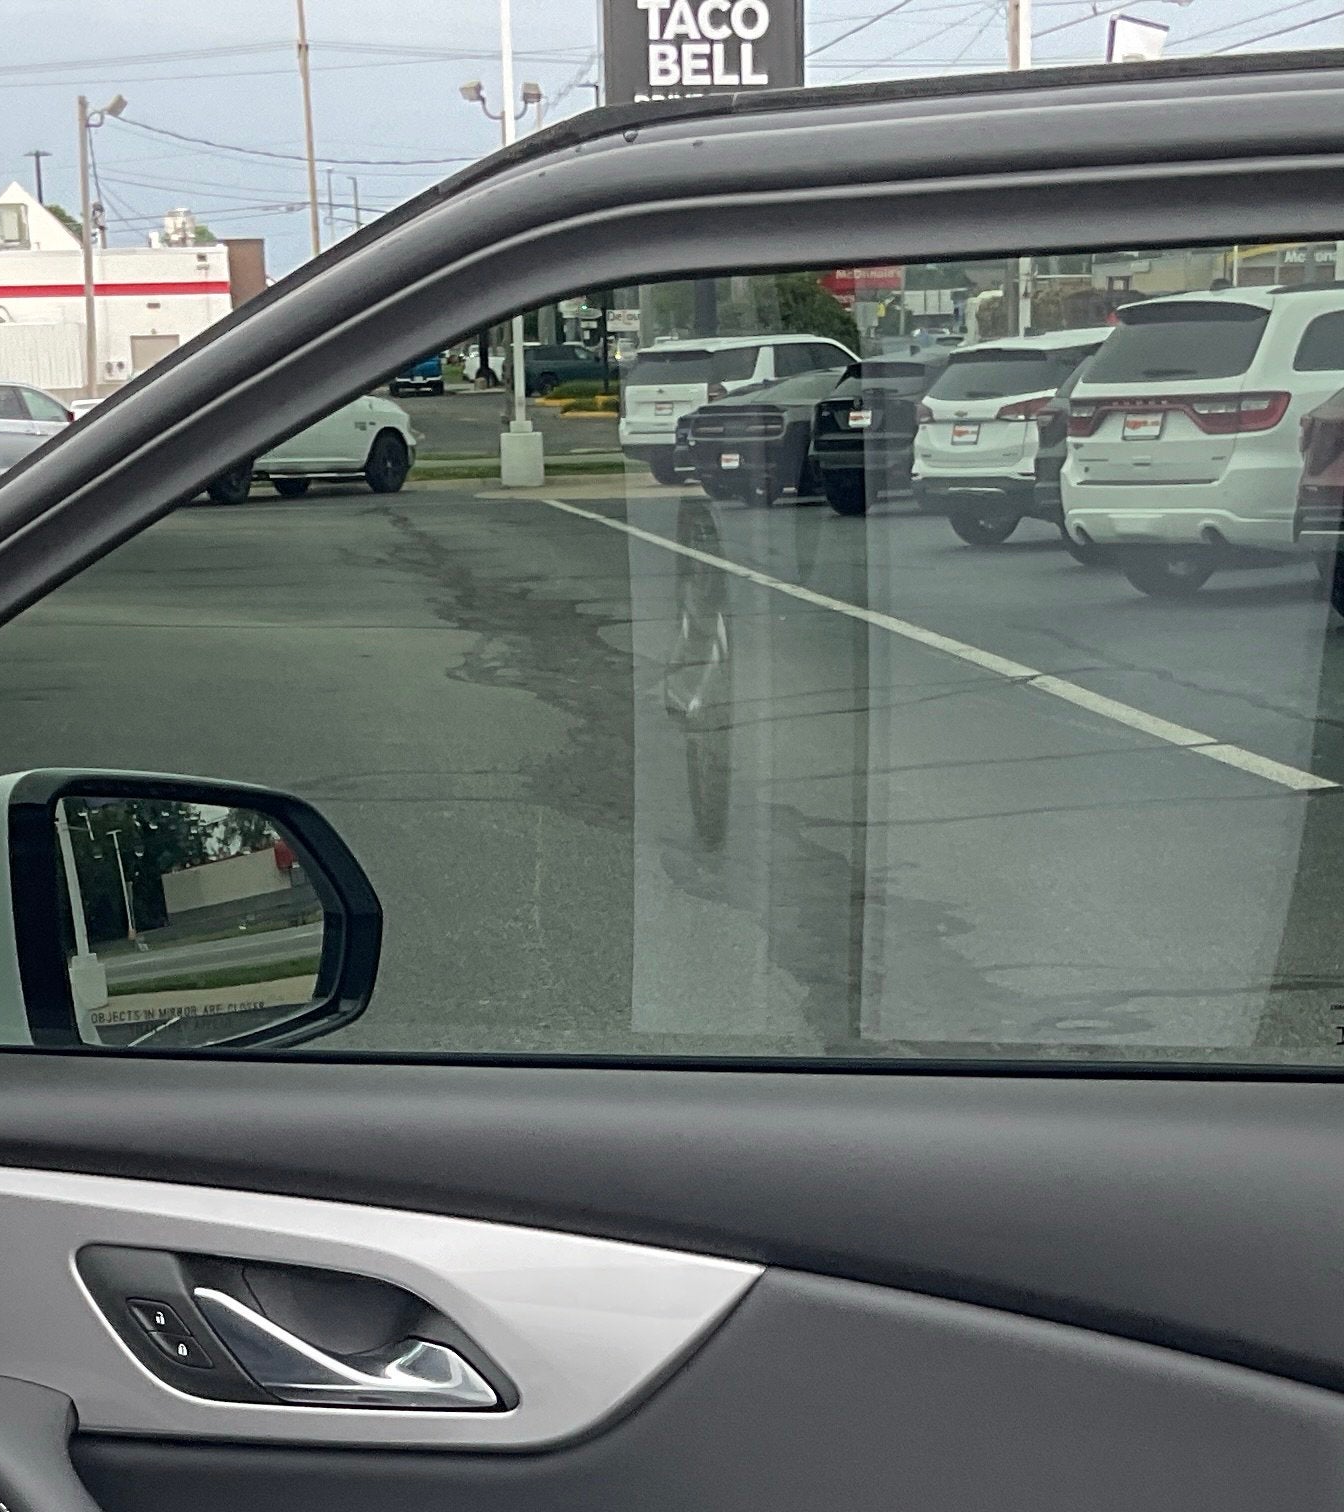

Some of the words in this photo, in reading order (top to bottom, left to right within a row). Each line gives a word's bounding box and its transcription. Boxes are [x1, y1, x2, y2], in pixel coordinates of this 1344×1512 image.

[637, 0, 769, 40] TACO
[649, 43, 768, 86] BELL
[91, 1009, 140, 1024] OBJECTS
[143, 1009, 154, 1021] IN
[156, 1005, 197, 1020] MIRROR
